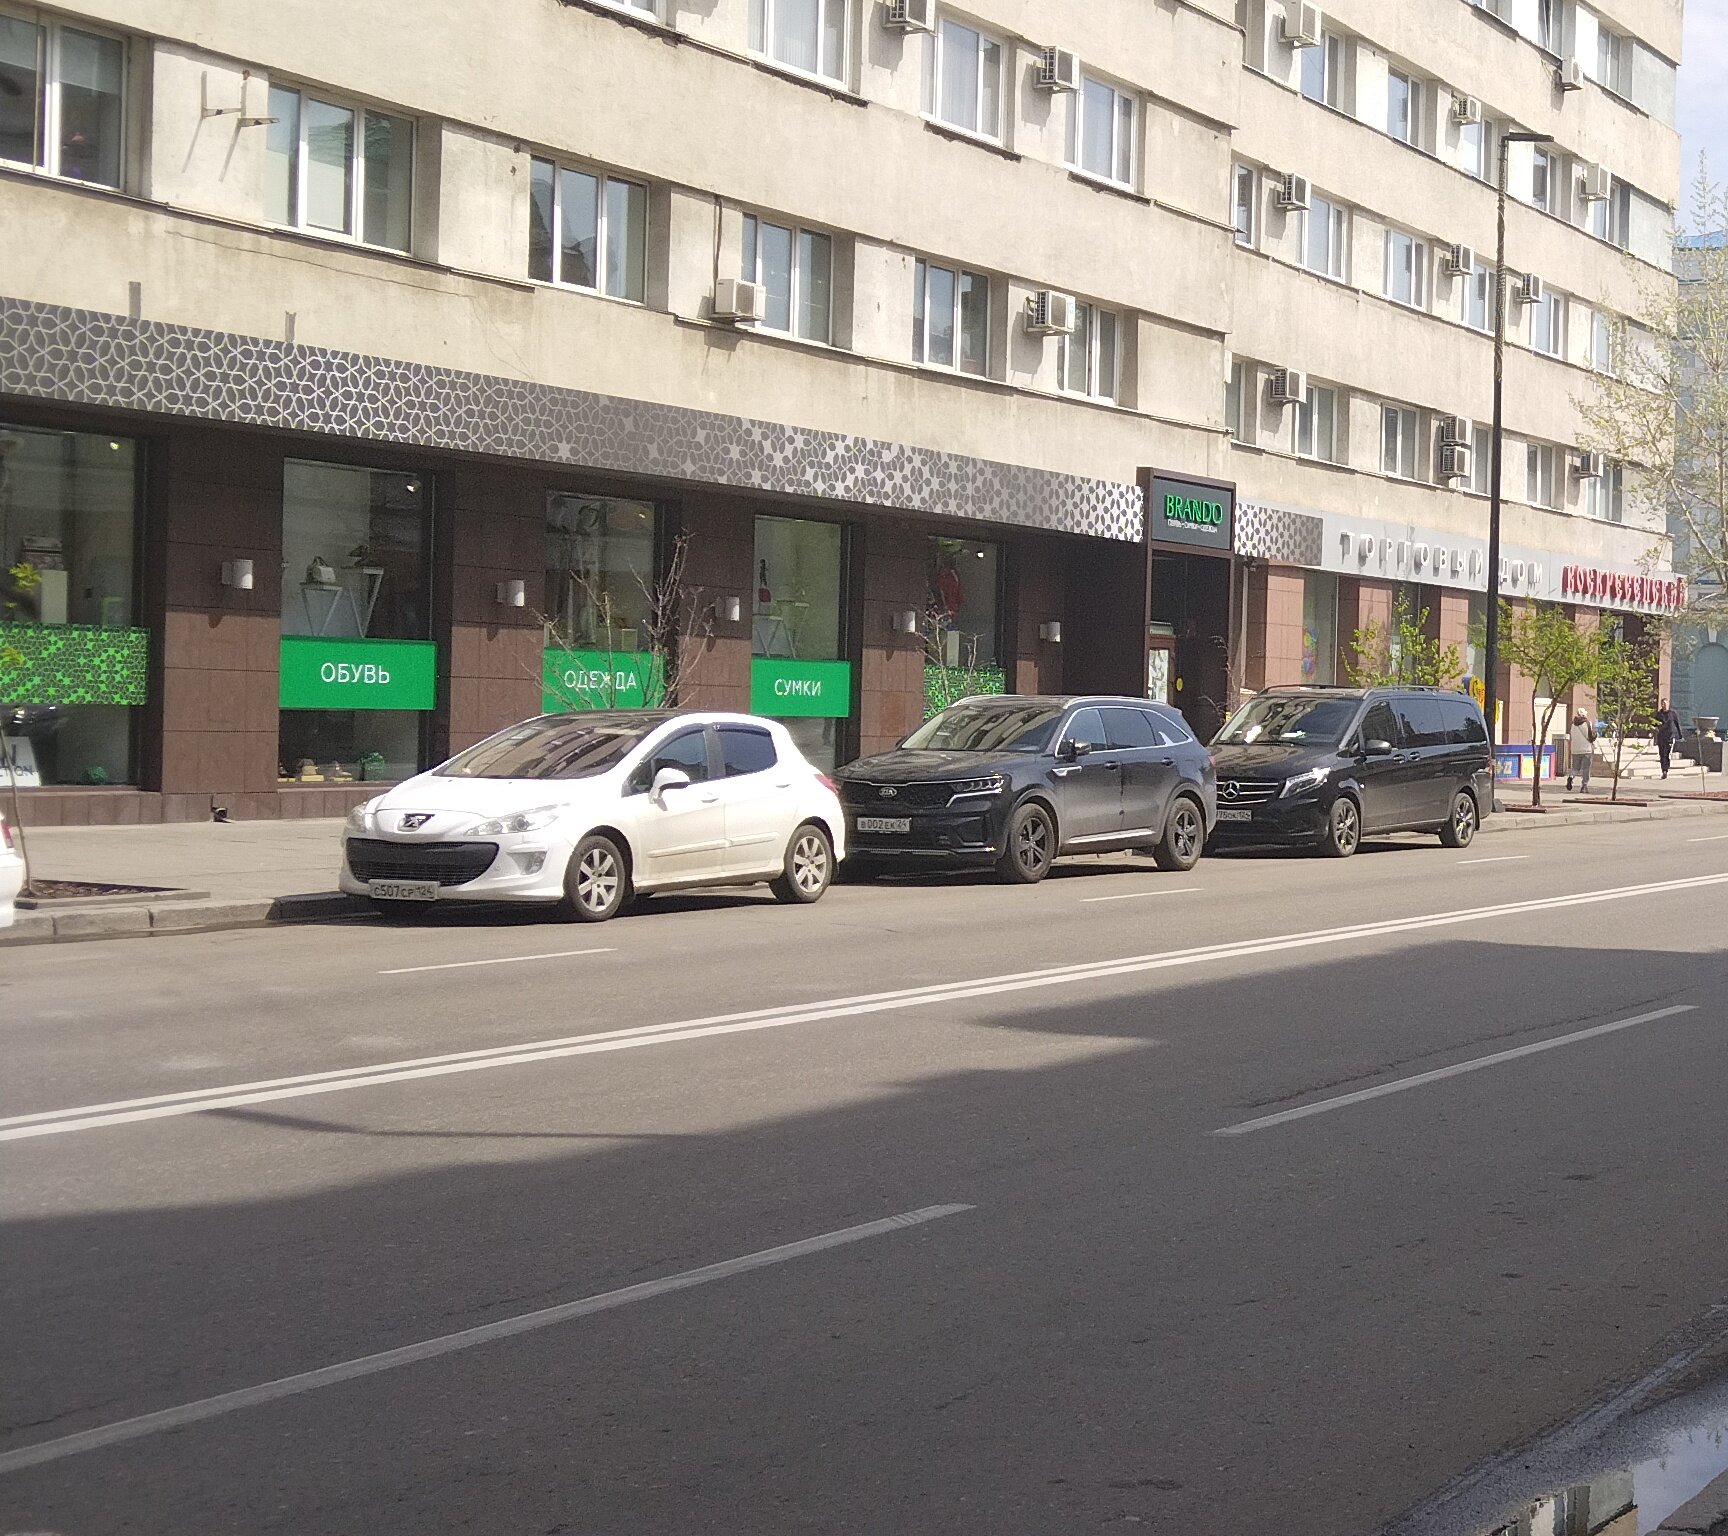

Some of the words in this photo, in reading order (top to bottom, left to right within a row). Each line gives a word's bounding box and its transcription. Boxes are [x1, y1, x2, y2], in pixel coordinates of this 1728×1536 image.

[1164, 494, 1223, 524] BRANDO
[1340, 531, 1484, 575] ТОРГОВЫЙ
[1498, 557, 1543, 583] ДОМ
[320, 662, 390, 684] ОБУВЬ
[563, 670, 637, 692] ОДЕЖДА
[773, 678, 822, 696] СУМКИ
